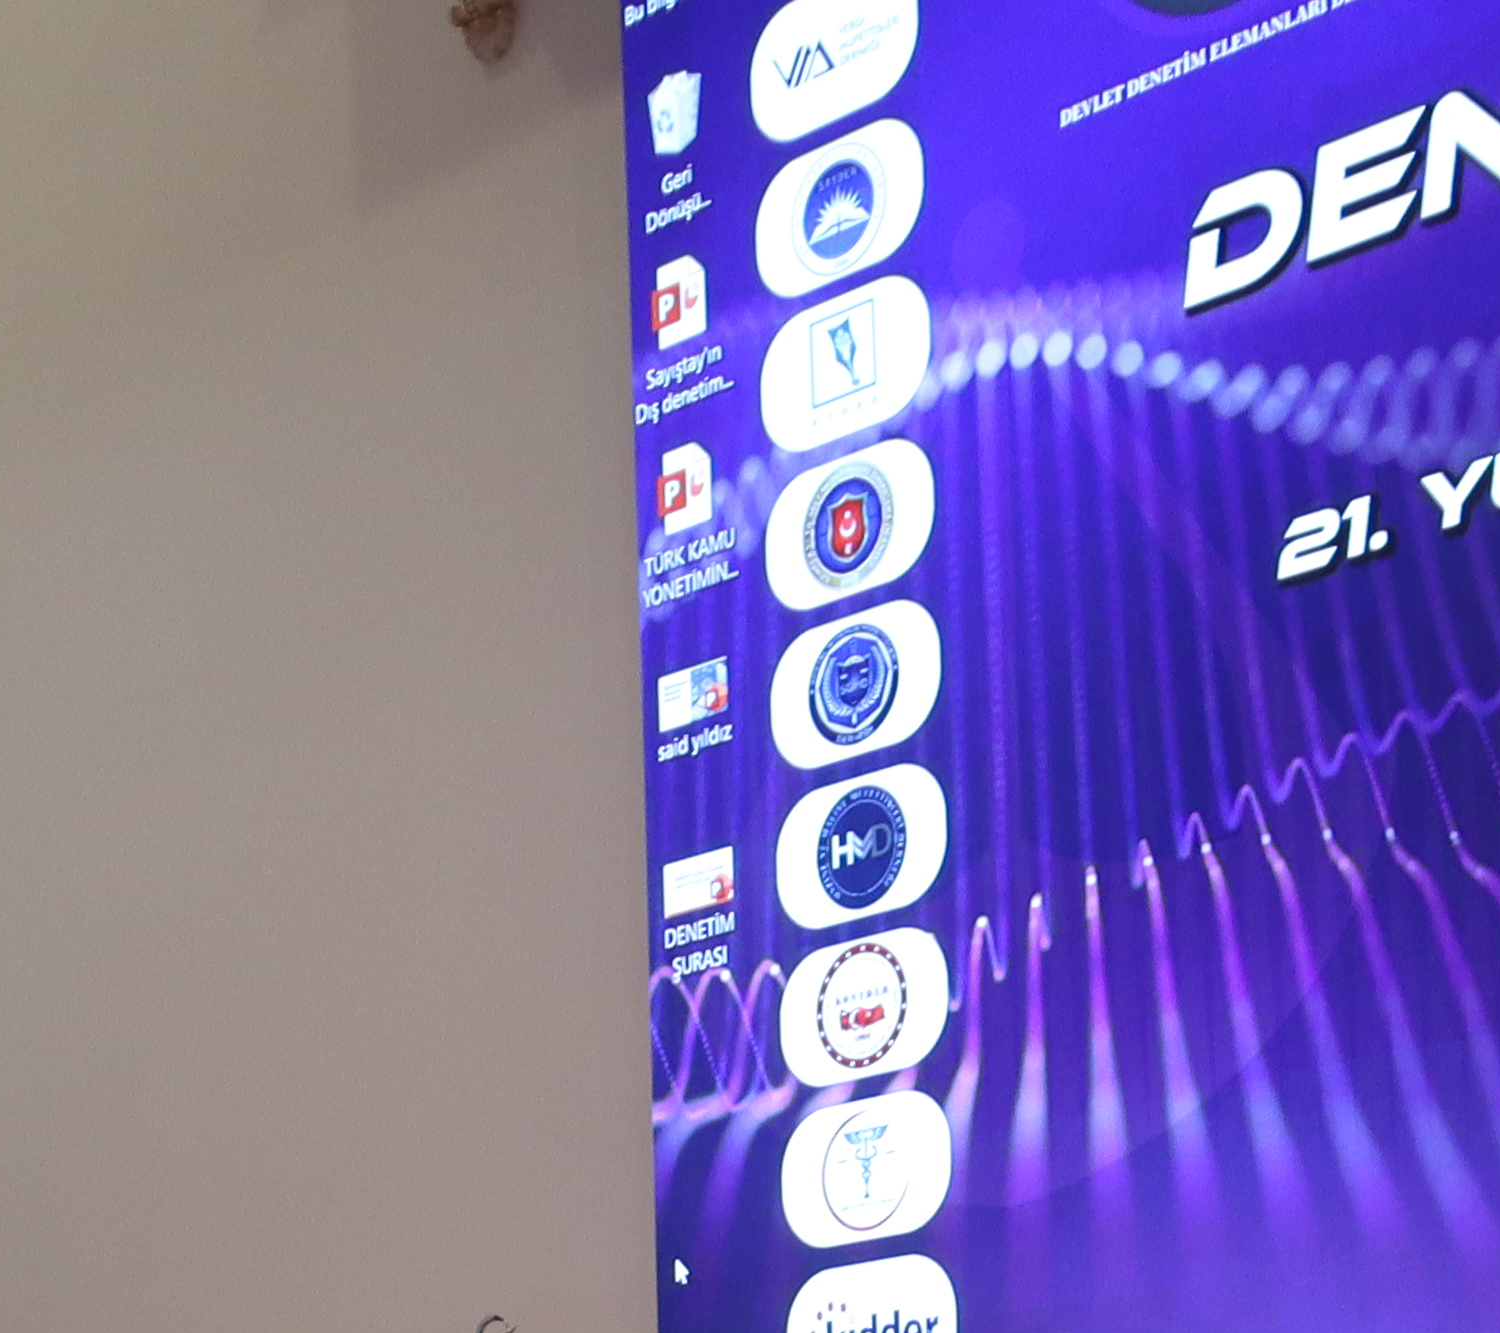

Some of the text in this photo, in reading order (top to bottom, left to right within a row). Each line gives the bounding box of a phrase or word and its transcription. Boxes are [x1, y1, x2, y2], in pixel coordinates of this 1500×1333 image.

[1060, 0, 1329, 128] DEVLET DENETİM ELEMANLARI
[661, 162, 693, 195] Geri
[635, 402, 660, 425] Dış
[643, 526, 736, 577] TÜRK KAMU
[1277, 495, 1389, 581] 21.
[657, 723, 733, 762] said yıldız
[664, 911, 735, 950] DENETİM
[671, 944, 728, 984] ŞURASI
